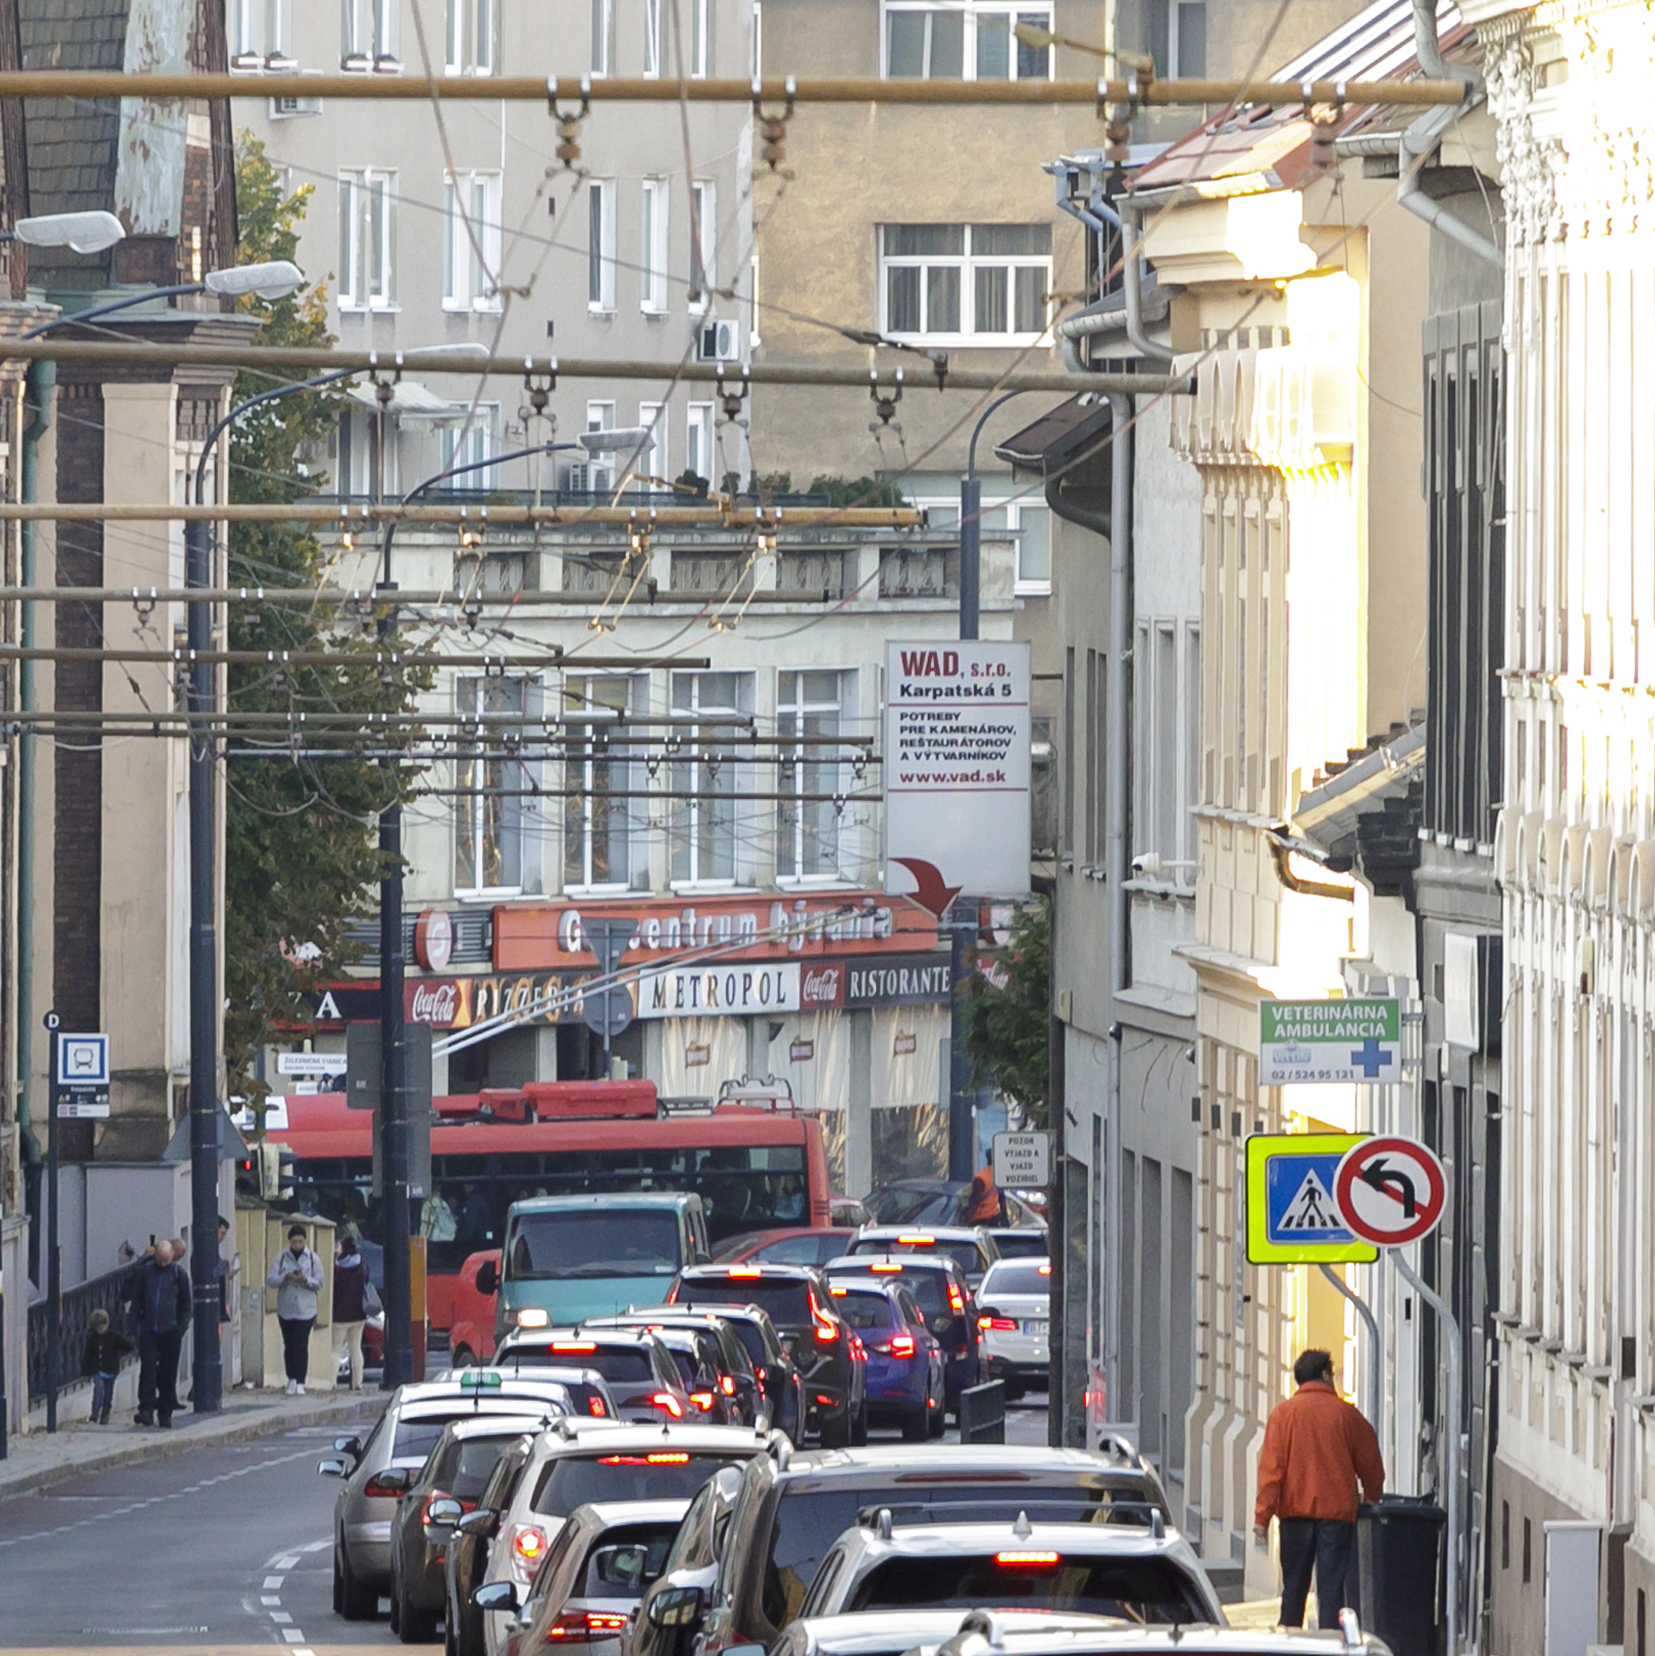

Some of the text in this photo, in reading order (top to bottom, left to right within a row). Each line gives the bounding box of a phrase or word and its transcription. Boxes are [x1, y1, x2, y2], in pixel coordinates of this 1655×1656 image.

[971, 662, 1011, 677] s.r.o.
[900, 683, 1012, 700] Karpatská 5
[900, 712, 961, 721] POTREBY
[900, 723, 1017, 736] PRE KAMENÁROV,
[900, 736, 1011, 748] REŠTAURÁTOROV
[900, 750, 1007, 761] A VÝTVARNÍKOV
[900, 769, 1006, 783] www.vad.sk
[849, 966, 950, 998] RISTORANTE
[652, 971, 786, 1009] METROPOL
[476, 985, 584, 1018] PIZZERIA
[1272, 1003, 1388, 1021] VETERINÁRNA
[48, 1013, 60, 1028] D
[1274, 1022, 1386, 1038] AMBULANCIA
[1272, 1070, 1285, 1080] 02
[1295, 1070, 1316, 1080] 524
[1318, 1070, 1332, 1080] 95
[1335, 1070, 1354, 1079] 121
